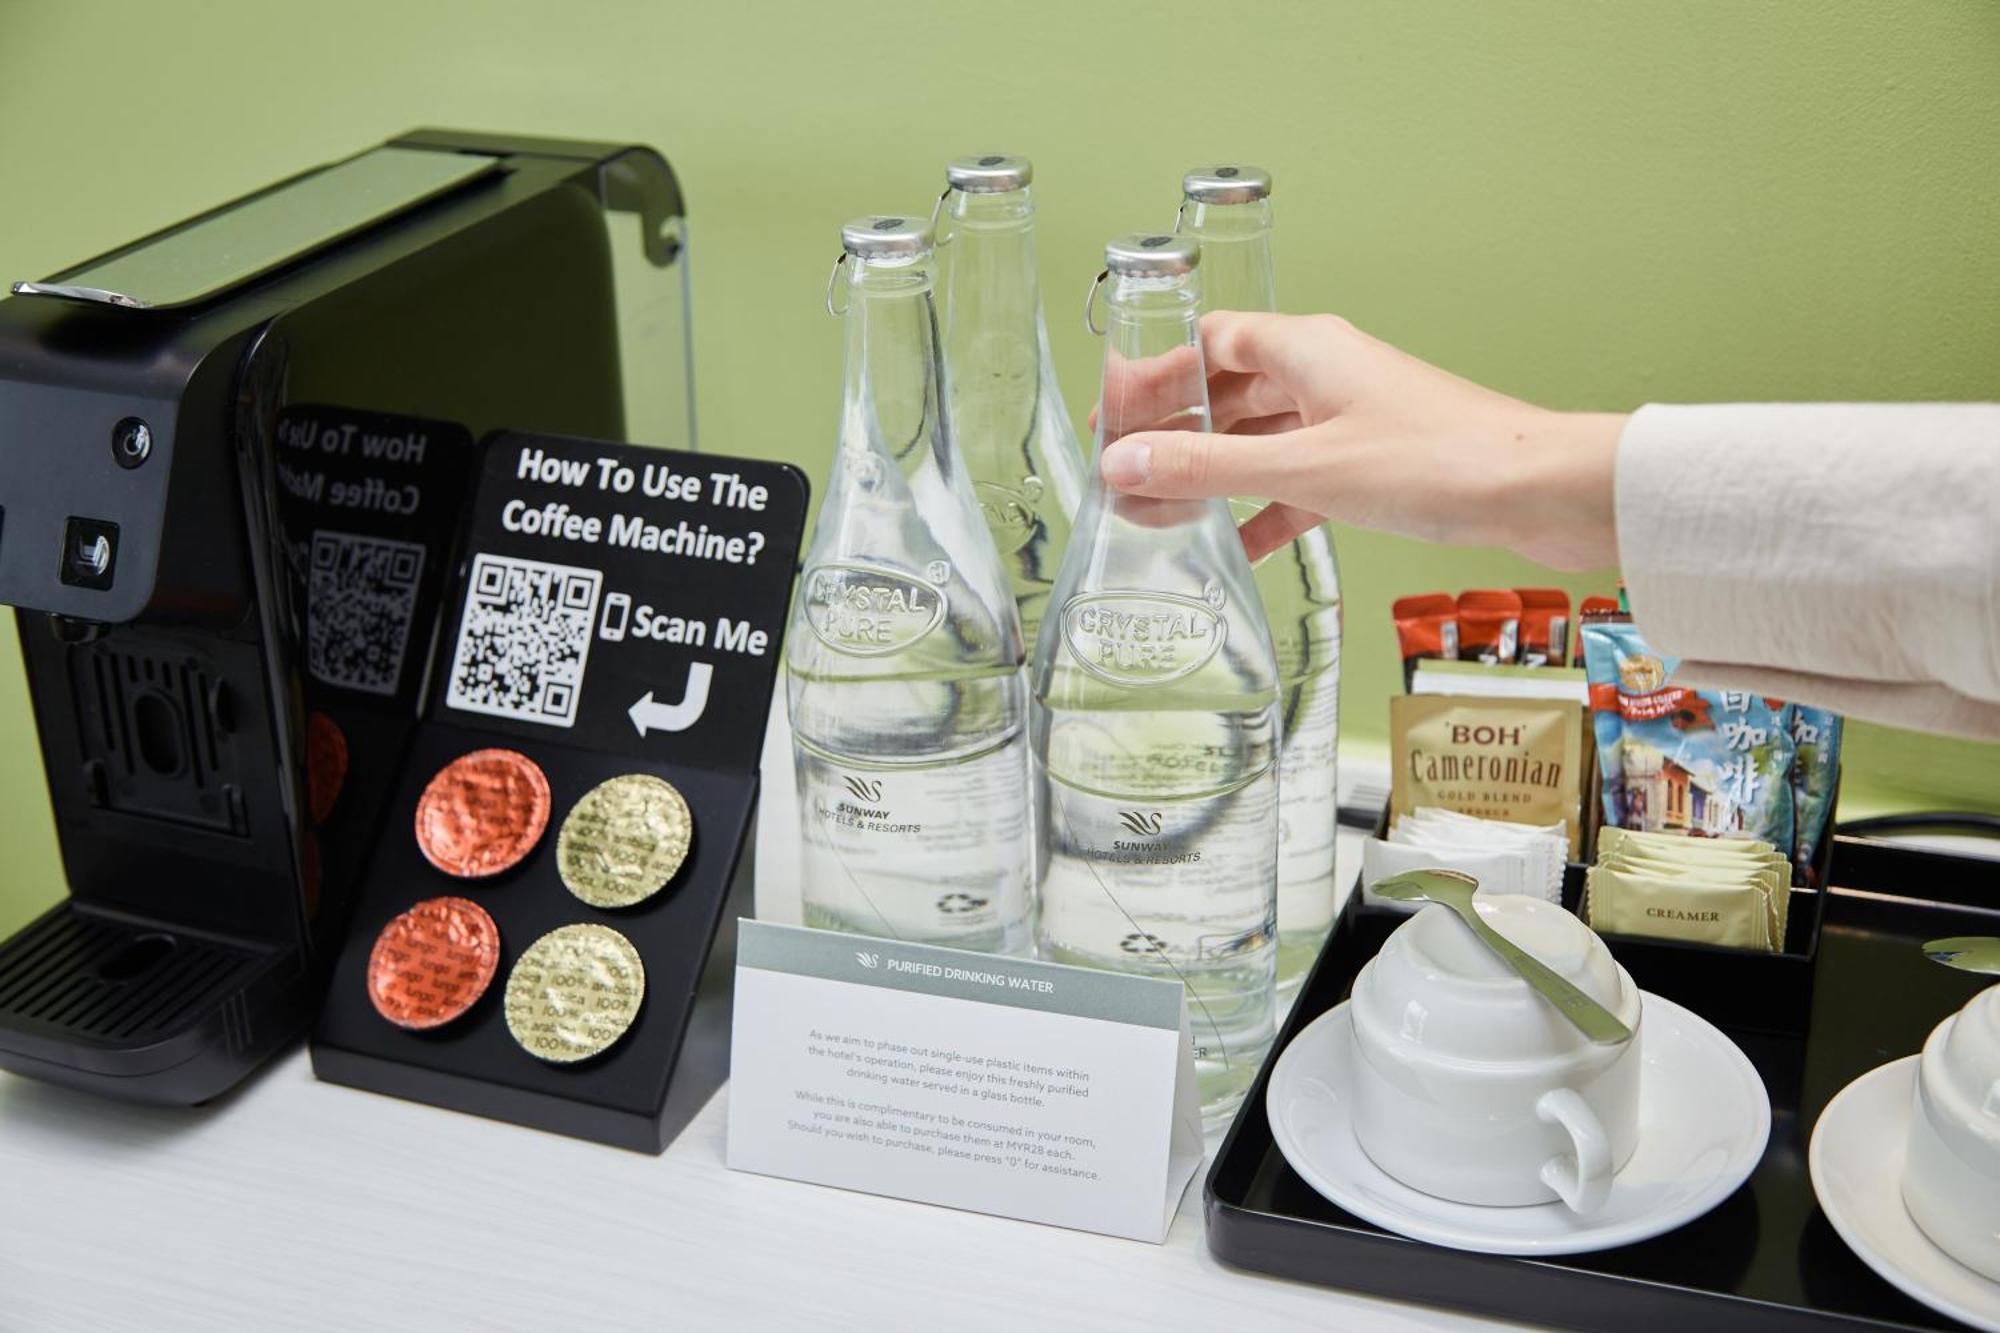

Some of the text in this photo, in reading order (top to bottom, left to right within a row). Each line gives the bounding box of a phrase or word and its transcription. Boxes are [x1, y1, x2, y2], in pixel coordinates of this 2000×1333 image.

[517, 448, 768, 511] How To Use The
[502, 499, 765, 565] Coffee Machine?
[631, 605, 768, 655] Scan Me
[1079, 607, 1207, 642] CRYSTAL
[1411, 749, 1562, 788] Cameronian
[837, 802, 890, 819] SUNWAY
[1437, 790, 1533, 803] GOLD BLEND
[819, 808, 921, 833] HOTELS & RESORTS
[1113, 840, 1171, 851] SUNWAY
[1646, 907, 1720, 921] CREAMER
[887, 958, 1054, 993] PURIFIED DRINKING WATER
[808, 1045, 1089, 1098] the hotel's operation, please enjoy this freshly purified
[809, 1029, 1090, 1081] As we aim to phase out single-use plastic items within
[846, 1068, 1045, 1107] drinking water served in a glass bottle.
[794, 1090, 1096, 1149] While this is complimentary to be consumed in your room,
[812, 1110, 832, 1122] you
[834, 1114, 849, 1123] are
[853, 1116, 873, 1127] also
[876, 1119, 898, 1131] able
[900, 1123, 911, 1135] to
[912, 1126, 960, 1142] purchase
[963, 1133, 991, 1146] them
[993, 1138, 1003, 1149] at
[1047, 1148, 1075, 1161] each.
[786, 1119, 822, 1135] Should
[824, 1128, 844, 1140] you
[846, 1130, 870, 1143] wish
[872, 1135, 883, 1146] to
[885, 1137, 936, 1155] purchase,
[938, 1145, 971, 1160] please
[974, 1151, 1003, 1165] press
[1024, 1158, 1040, 1171] for
[1041, 1163, 1101, 1181] assistance.
